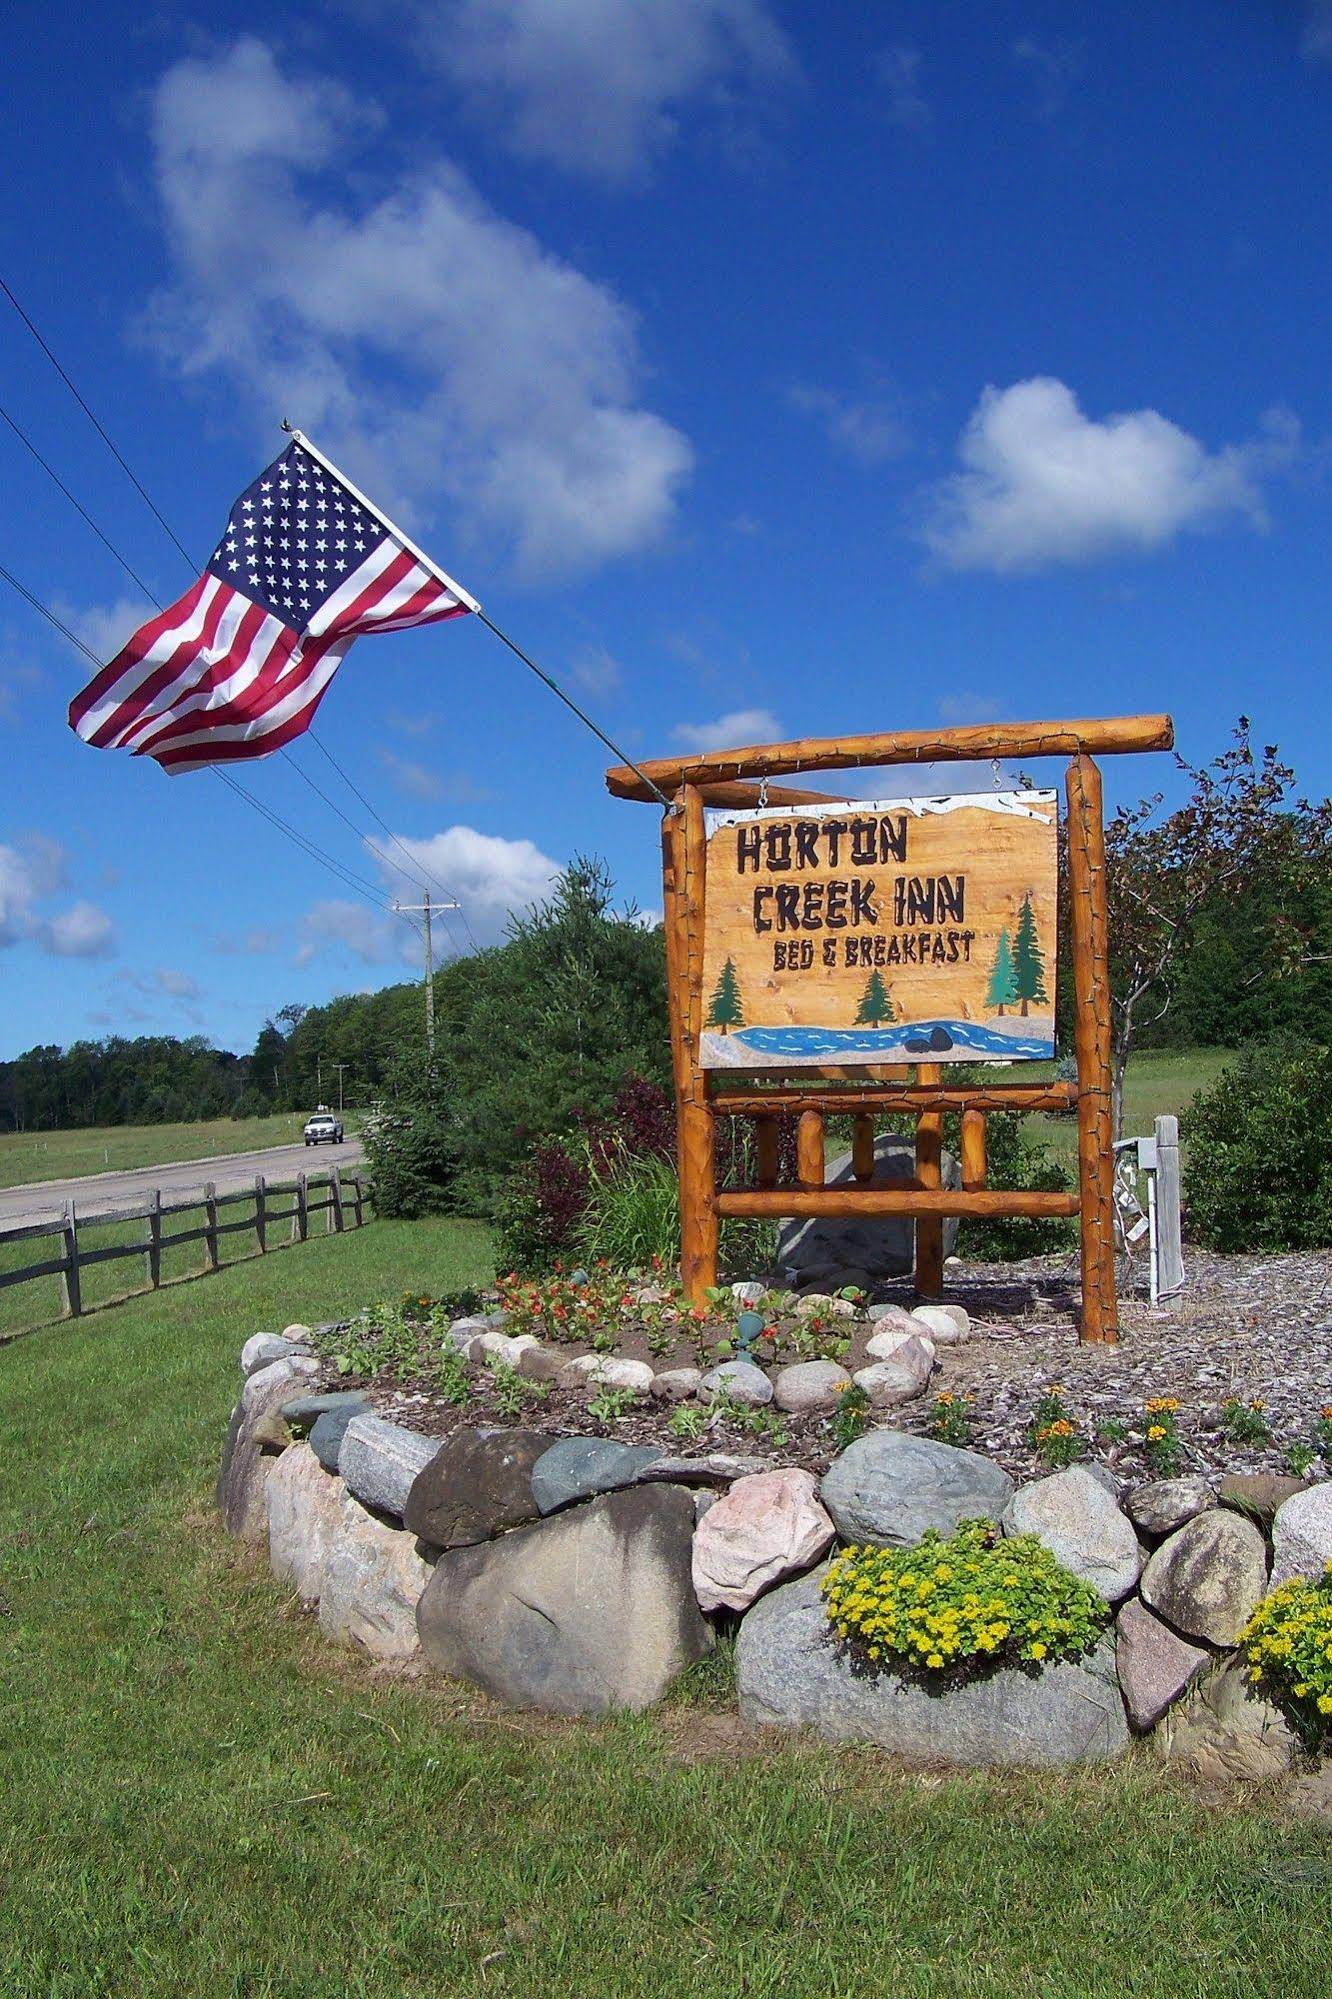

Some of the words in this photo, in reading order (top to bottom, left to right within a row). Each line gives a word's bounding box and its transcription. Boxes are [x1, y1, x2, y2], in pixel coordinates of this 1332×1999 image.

[737, 816, 908, 874] HORTON
[753, 879, 878, 933] CREEK
[894, 875, 965, 926] INN
[773, 940, 814, 971] BED
[822, 936, 837, 967] &
[845, 930, 975, 967] BREAKFAST
